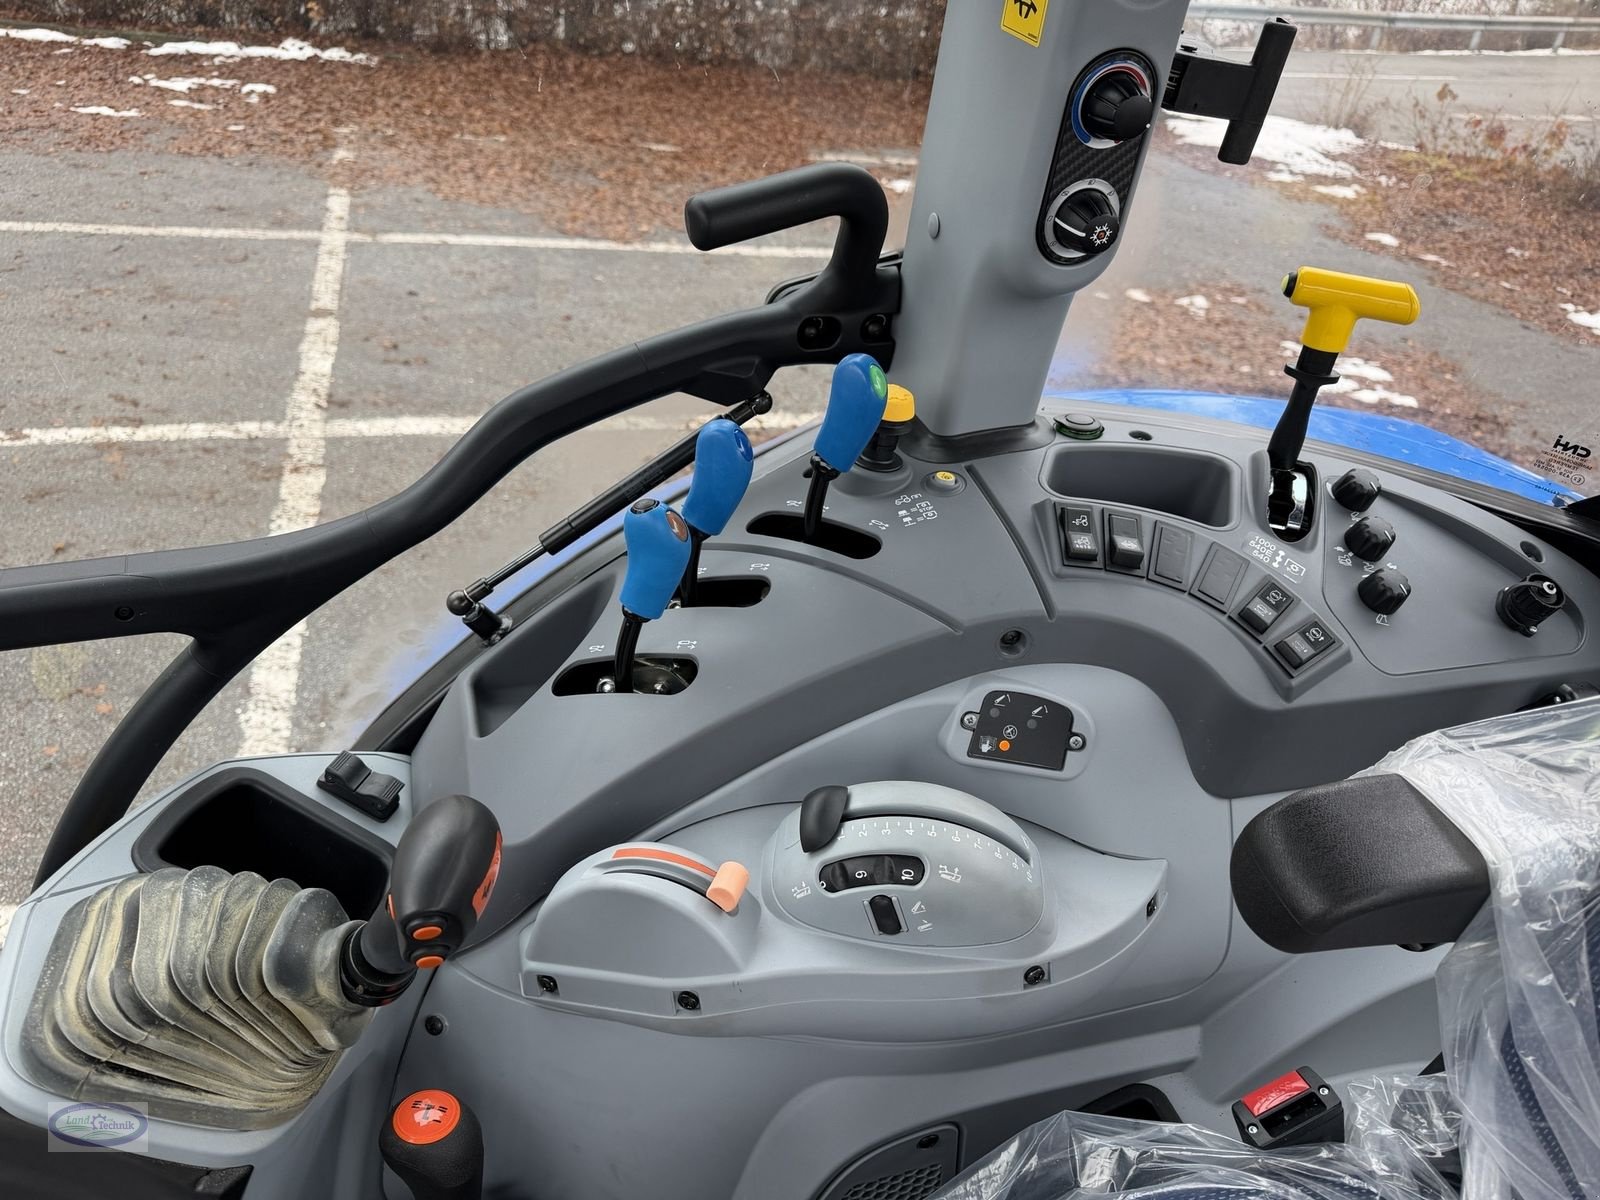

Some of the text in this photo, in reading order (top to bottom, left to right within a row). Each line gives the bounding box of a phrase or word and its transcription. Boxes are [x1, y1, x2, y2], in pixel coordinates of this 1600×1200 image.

[1249, 540, 1273, 558] 540E
[1255, 535, 1276, 551] 1000
[1252, 549, 1270, 563] 540
[855, 870, 868, 879] 9
[901, 868, 914, 881] 10
